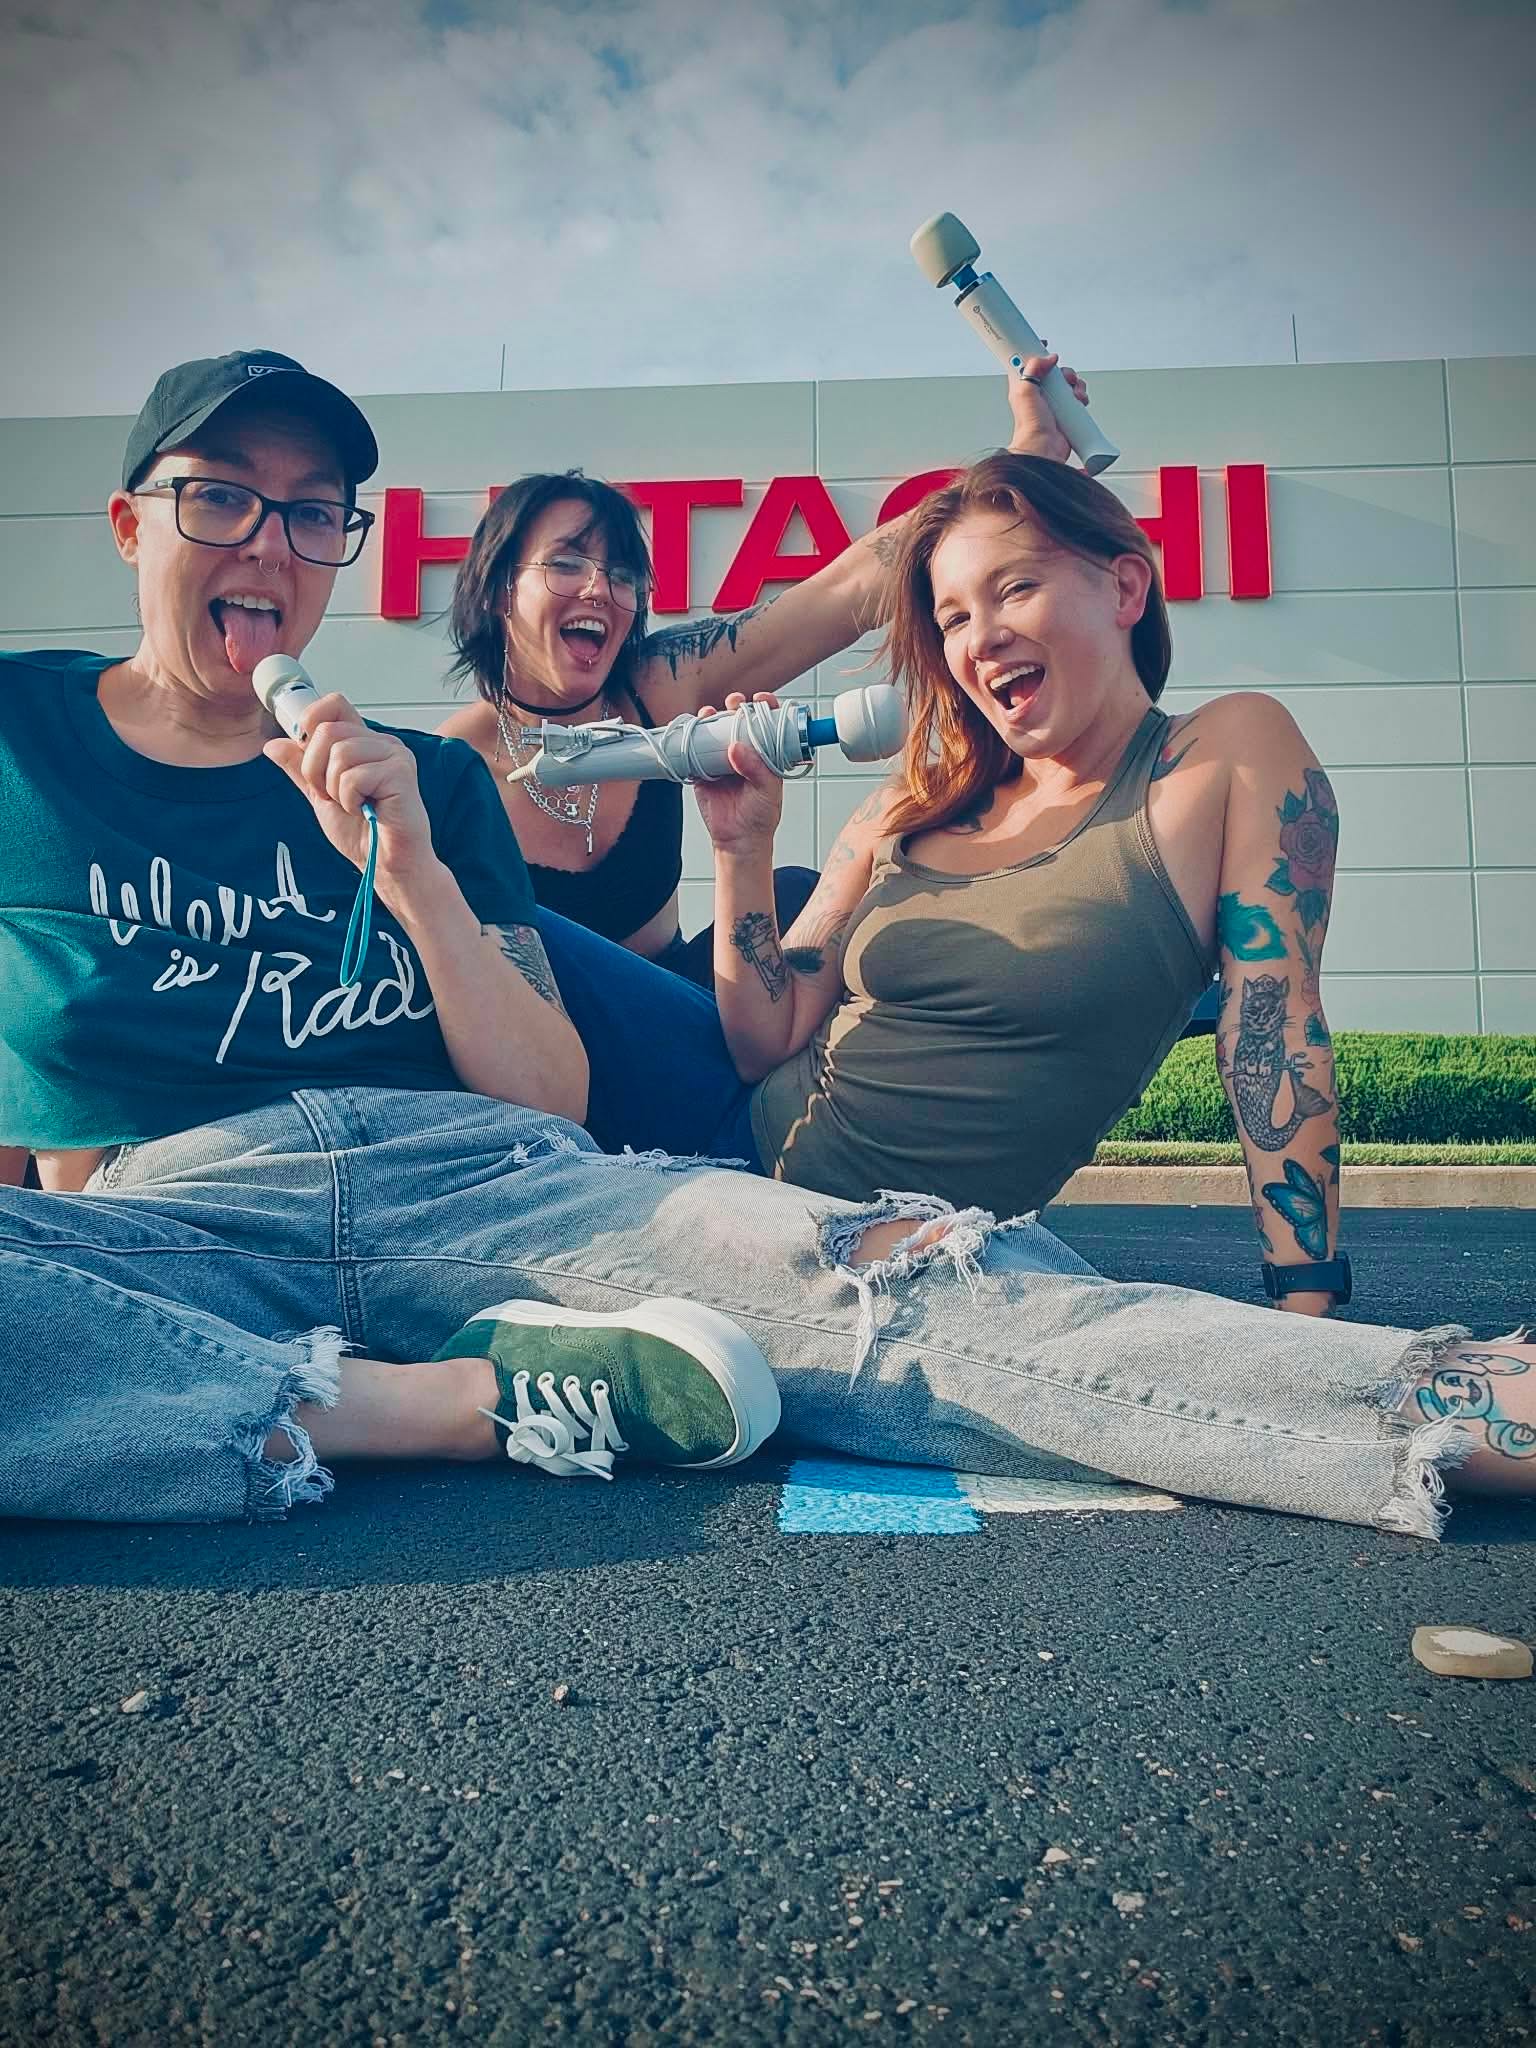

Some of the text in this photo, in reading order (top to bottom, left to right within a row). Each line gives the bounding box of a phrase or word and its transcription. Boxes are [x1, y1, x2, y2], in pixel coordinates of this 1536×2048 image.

[381, 464, 1272, 619] HTAHI
[152, 930, 435, 1065] is Rad
